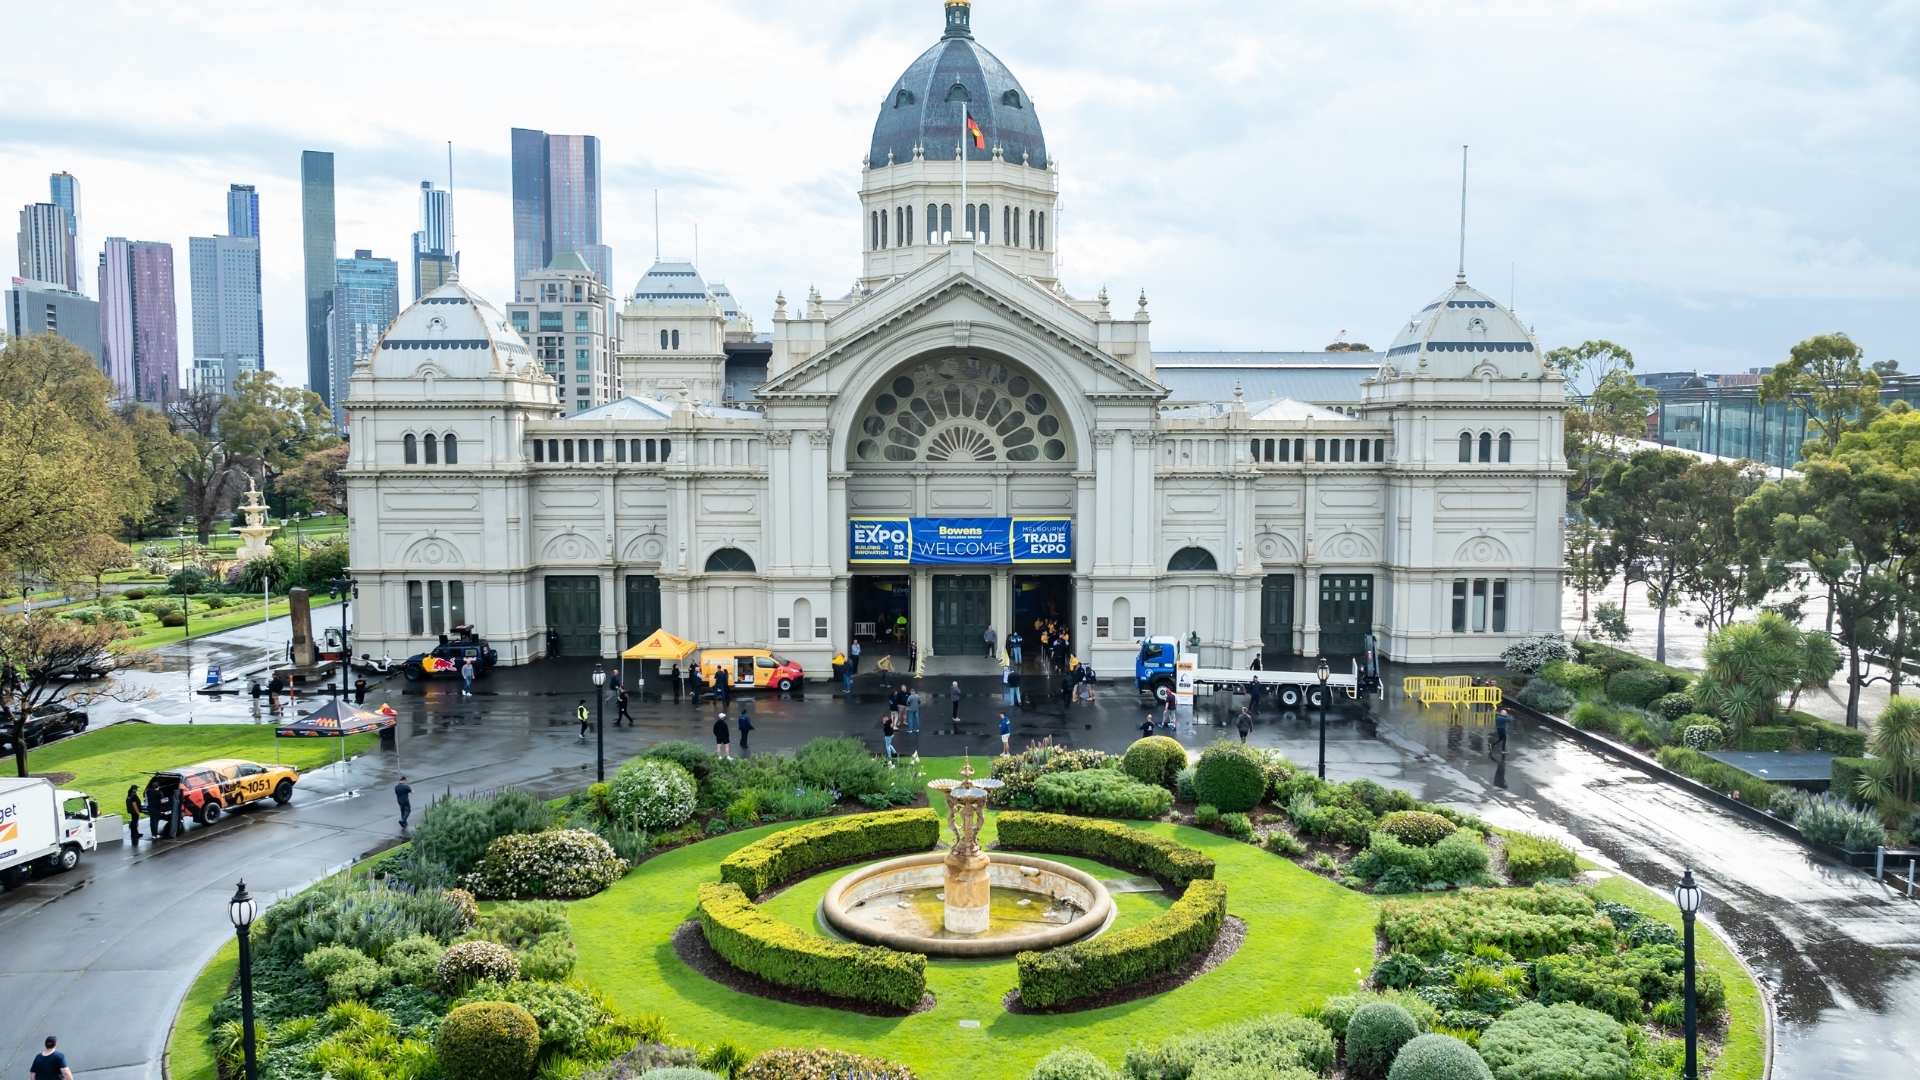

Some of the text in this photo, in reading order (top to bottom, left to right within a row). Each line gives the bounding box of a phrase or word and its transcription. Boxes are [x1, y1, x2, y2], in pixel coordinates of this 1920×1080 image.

[855, 525, 904, 543] EXPO
[939, 526, 983, 535] Bowens
[1022, 533, 1066, 543] TRADE
[918, 542, 1004, 555] WELCOME
[1030, 544, 1066, 554] EXPO
